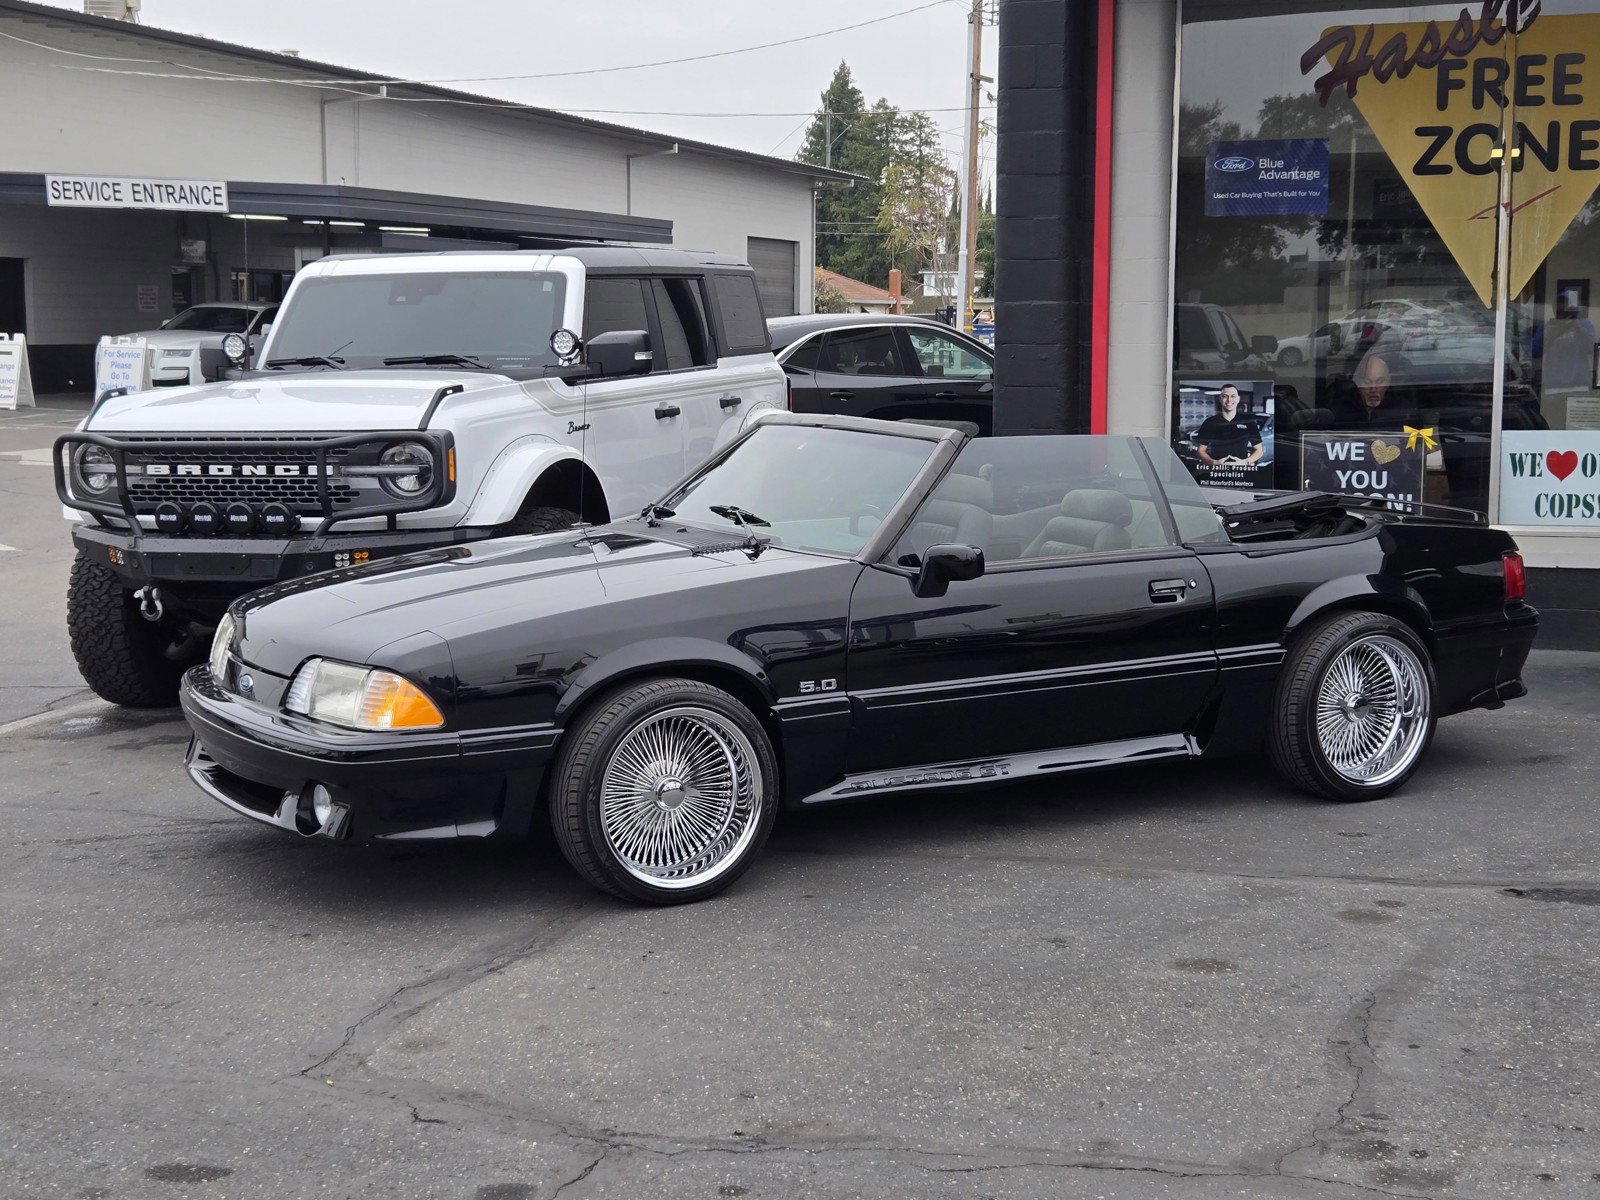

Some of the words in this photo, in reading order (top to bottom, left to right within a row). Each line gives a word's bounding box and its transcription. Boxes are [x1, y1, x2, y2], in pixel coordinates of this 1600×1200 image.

[1436, 52, 1586, 112] FREE
[1412, 119, 1600, 176] ZONE
[1258, 159, 1284, 168] Blue
[1258, 170, 1321, 180] Advantage
[51, 180, 123, 202] SERVICE
[131, 183, 224, 206] ENTRANCE
[104, 350, 115, 358] For
[116, 350, 141, 358] Service
[110, 361, 132, 369] Please
[111, 372, 120, 380] Go
[122, 372, 130, 380] To
[1325, 442, 1365, 461] WE
[146, 464, 334, 476] BRONCO
[1509, 452, 1543, 477] WE
[1581, 452, 1600, 478] O
[1336, 470, 1388, 489] YOU
[800, 678, 838, 693] 5.0
[979, 762, 1011, 777] GT
